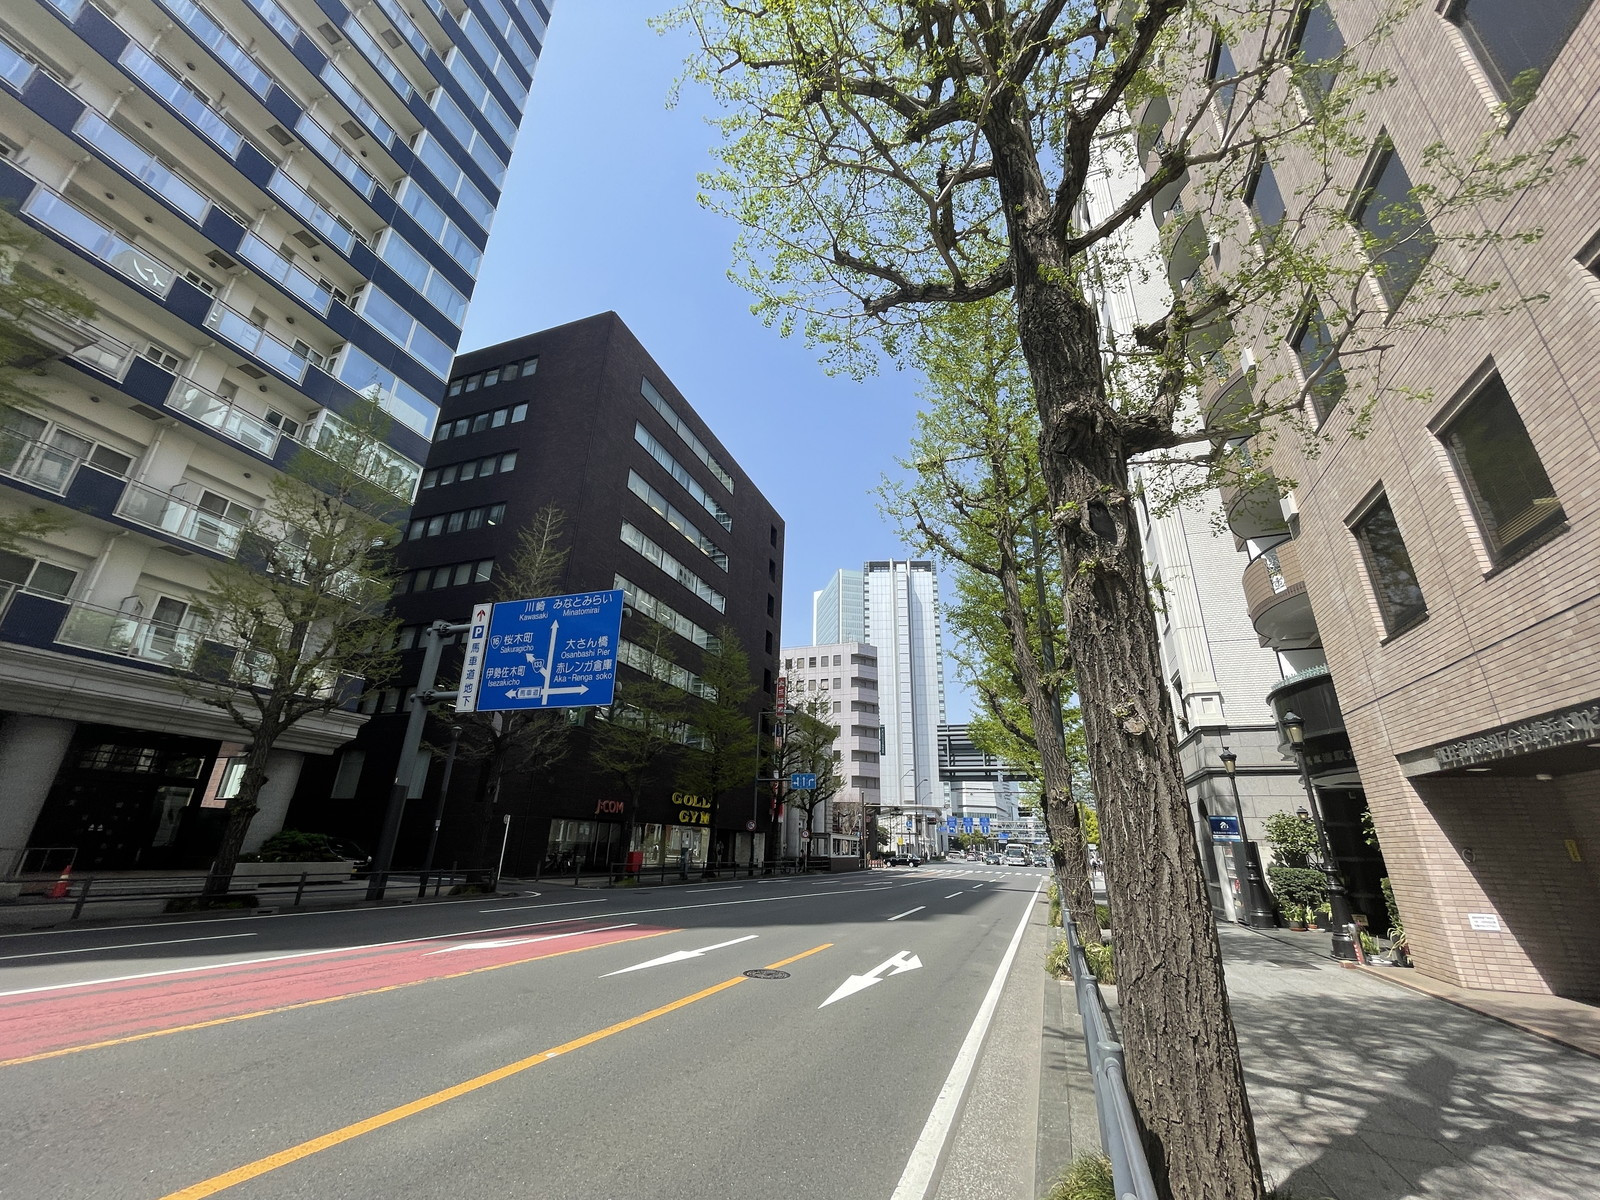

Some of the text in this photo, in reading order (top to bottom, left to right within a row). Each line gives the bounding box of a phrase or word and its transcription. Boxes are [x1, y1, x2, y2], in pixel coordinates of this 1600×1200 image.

[525, 601, 545, 612] 川崎
[553, 594, 613, 609] みなとみらい
[519, 611, 549, 621] Kawasaki
[563, 606, 600, 616] Minatomirai
[504, 632, 534, 645] 桜木町
[565, 635, 609, 650] 大さん橋
[500, 645, 534, 654] Sakuragicho
[561, 648, 610, 659] Osanbashi Pier
[486, 665, 526, 679] 伊勢佐木町
[556, 659, 613, 674] 赤レンガ倉庫
[463, 642, 480, 707] 馬車道地下
[595, 672, 613, 681] soko
[488, 678, 521, 687] Isezakicho
[678, 809, 711, 825] GYM
